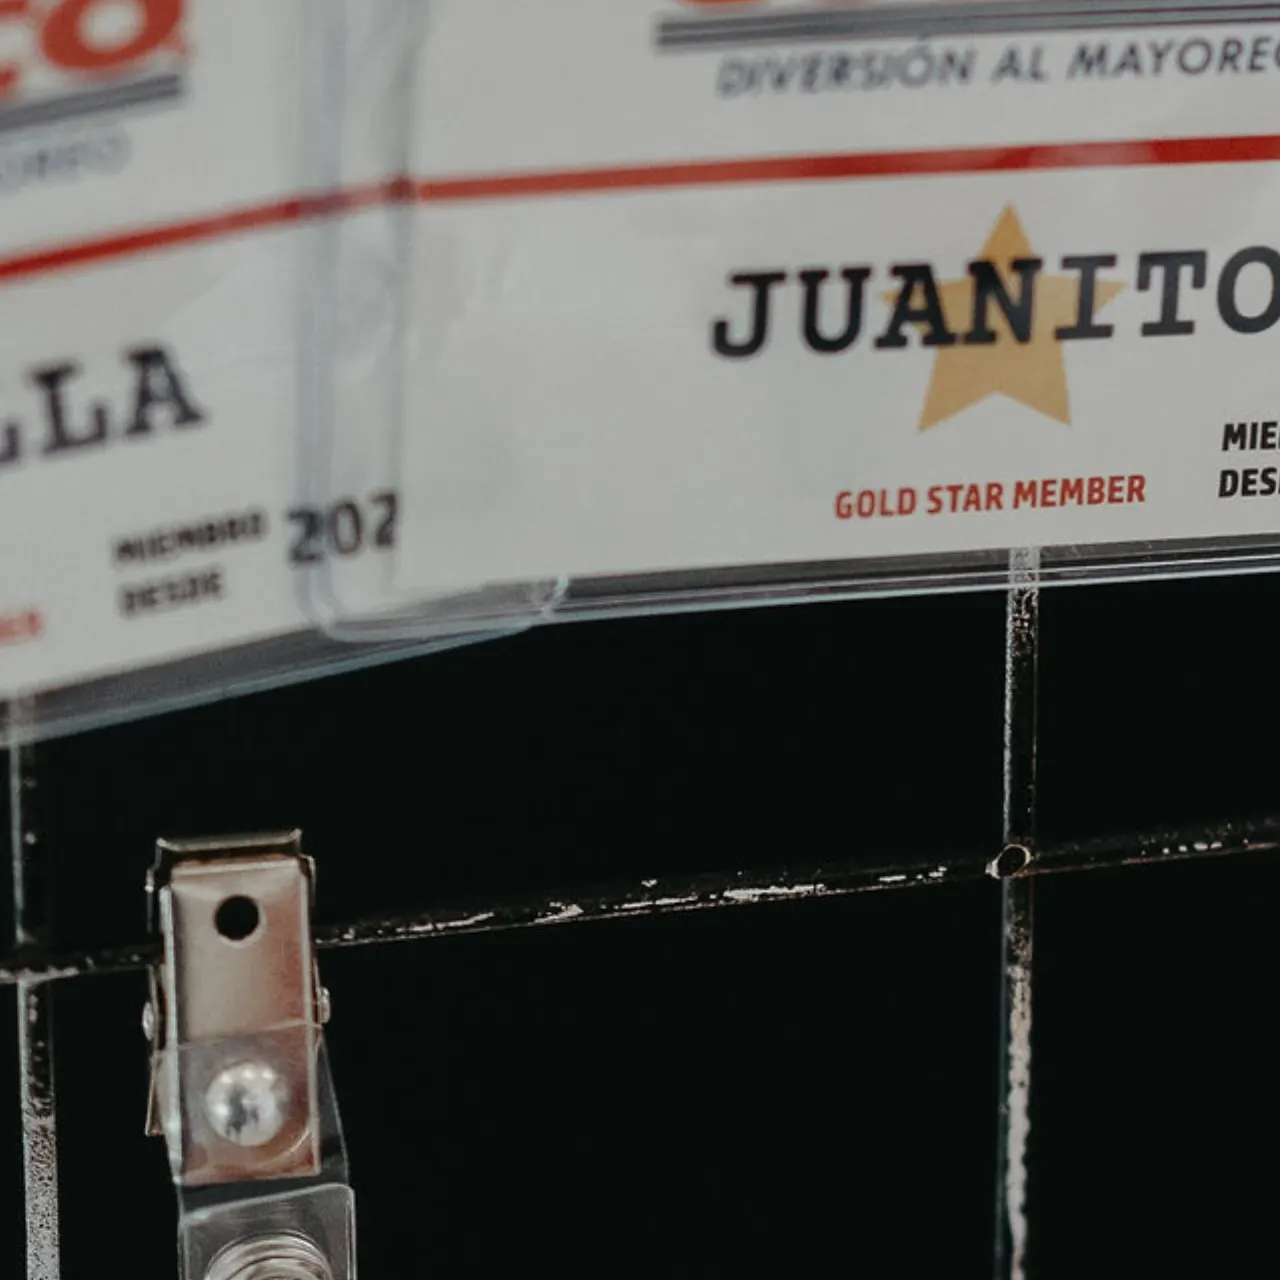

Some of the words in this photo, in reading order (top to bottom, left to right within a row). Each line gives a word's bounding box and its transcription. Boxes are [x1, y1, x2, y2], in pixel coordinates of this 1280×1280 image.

[716, 34, 977, 98] DIVERSIÓN
[992, 47, 1050, 84] AL
[834, 487, 918, 520] GOLD
[926, 480, 1004, 515] STAR
[1012, 473, 1147, 510] MEMBER
